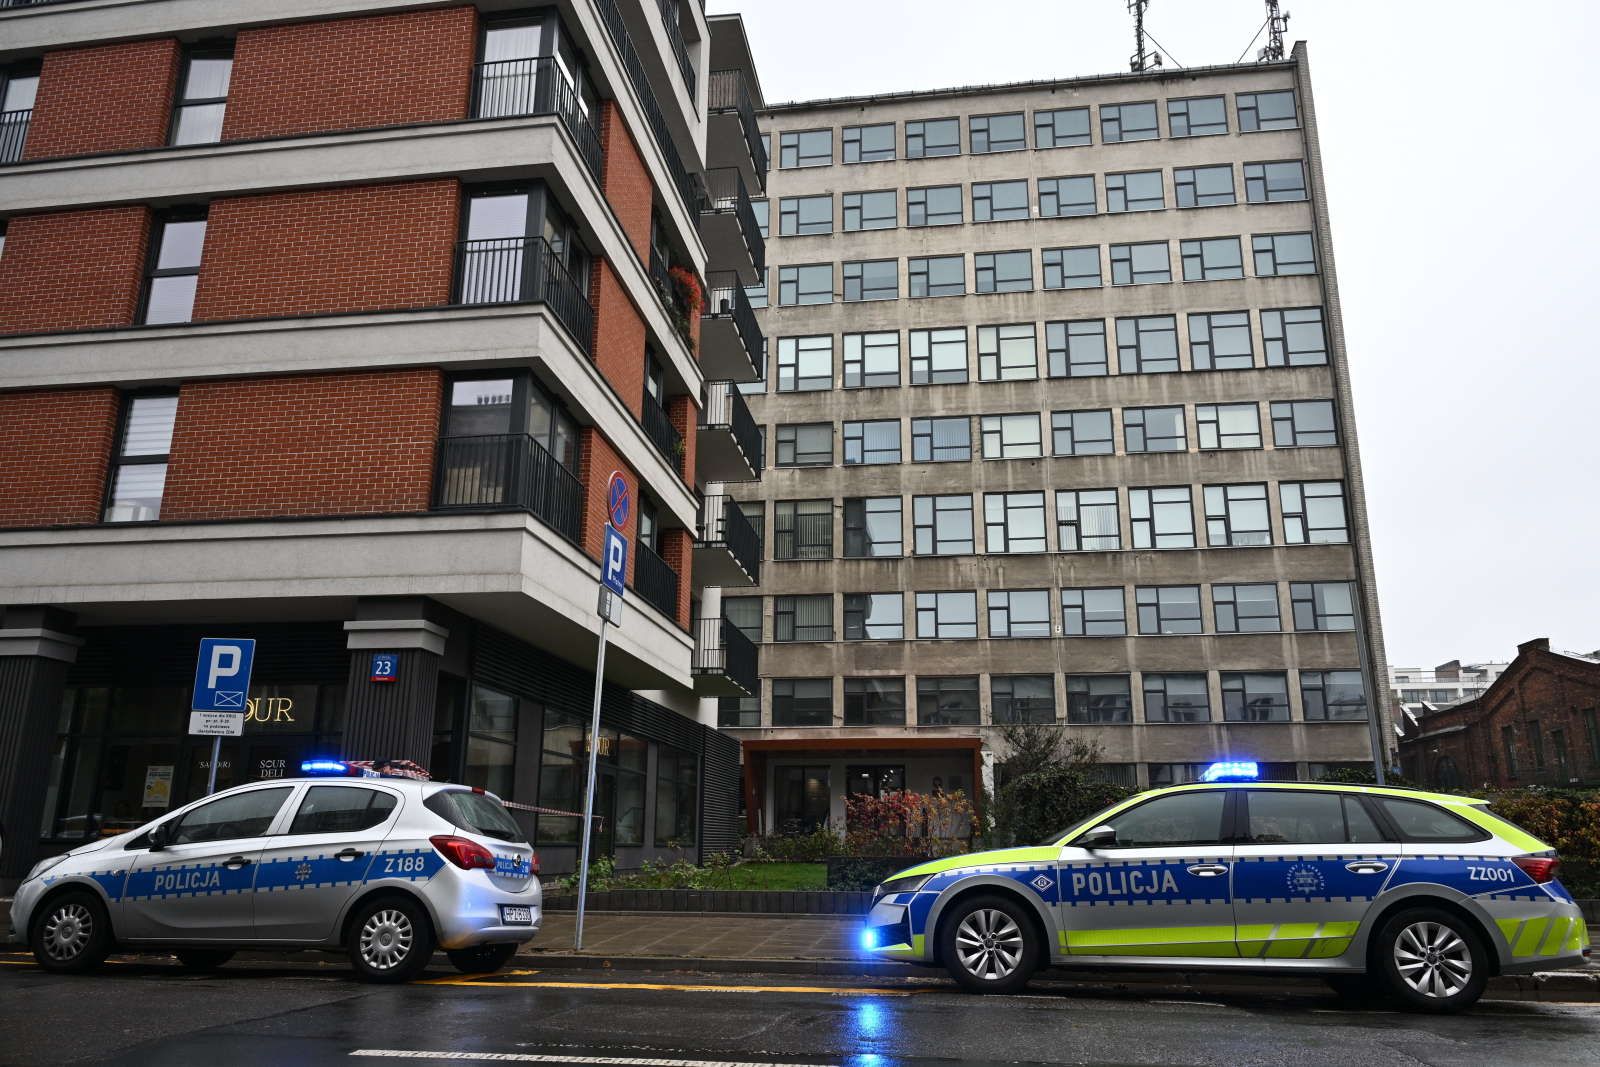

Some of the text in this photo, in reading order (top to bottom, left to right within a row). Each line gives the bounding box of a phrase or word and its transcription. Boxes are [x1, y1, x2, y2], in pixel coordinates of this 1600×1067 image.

[608, 534, 623, 580] P
[207, 645, 242, 689] P
[375, 661, 391, 675] 23
[260, 760, 286, 769] SOUR
[260, 769, 284, 778] DELI
[497, 861, 513, 870] POLICJA
[154, 870, 221, 891] POLICJA
[1072, 870, 1179, 896] POLICJA
[1466, 866, 1515, 883] ZZ001
